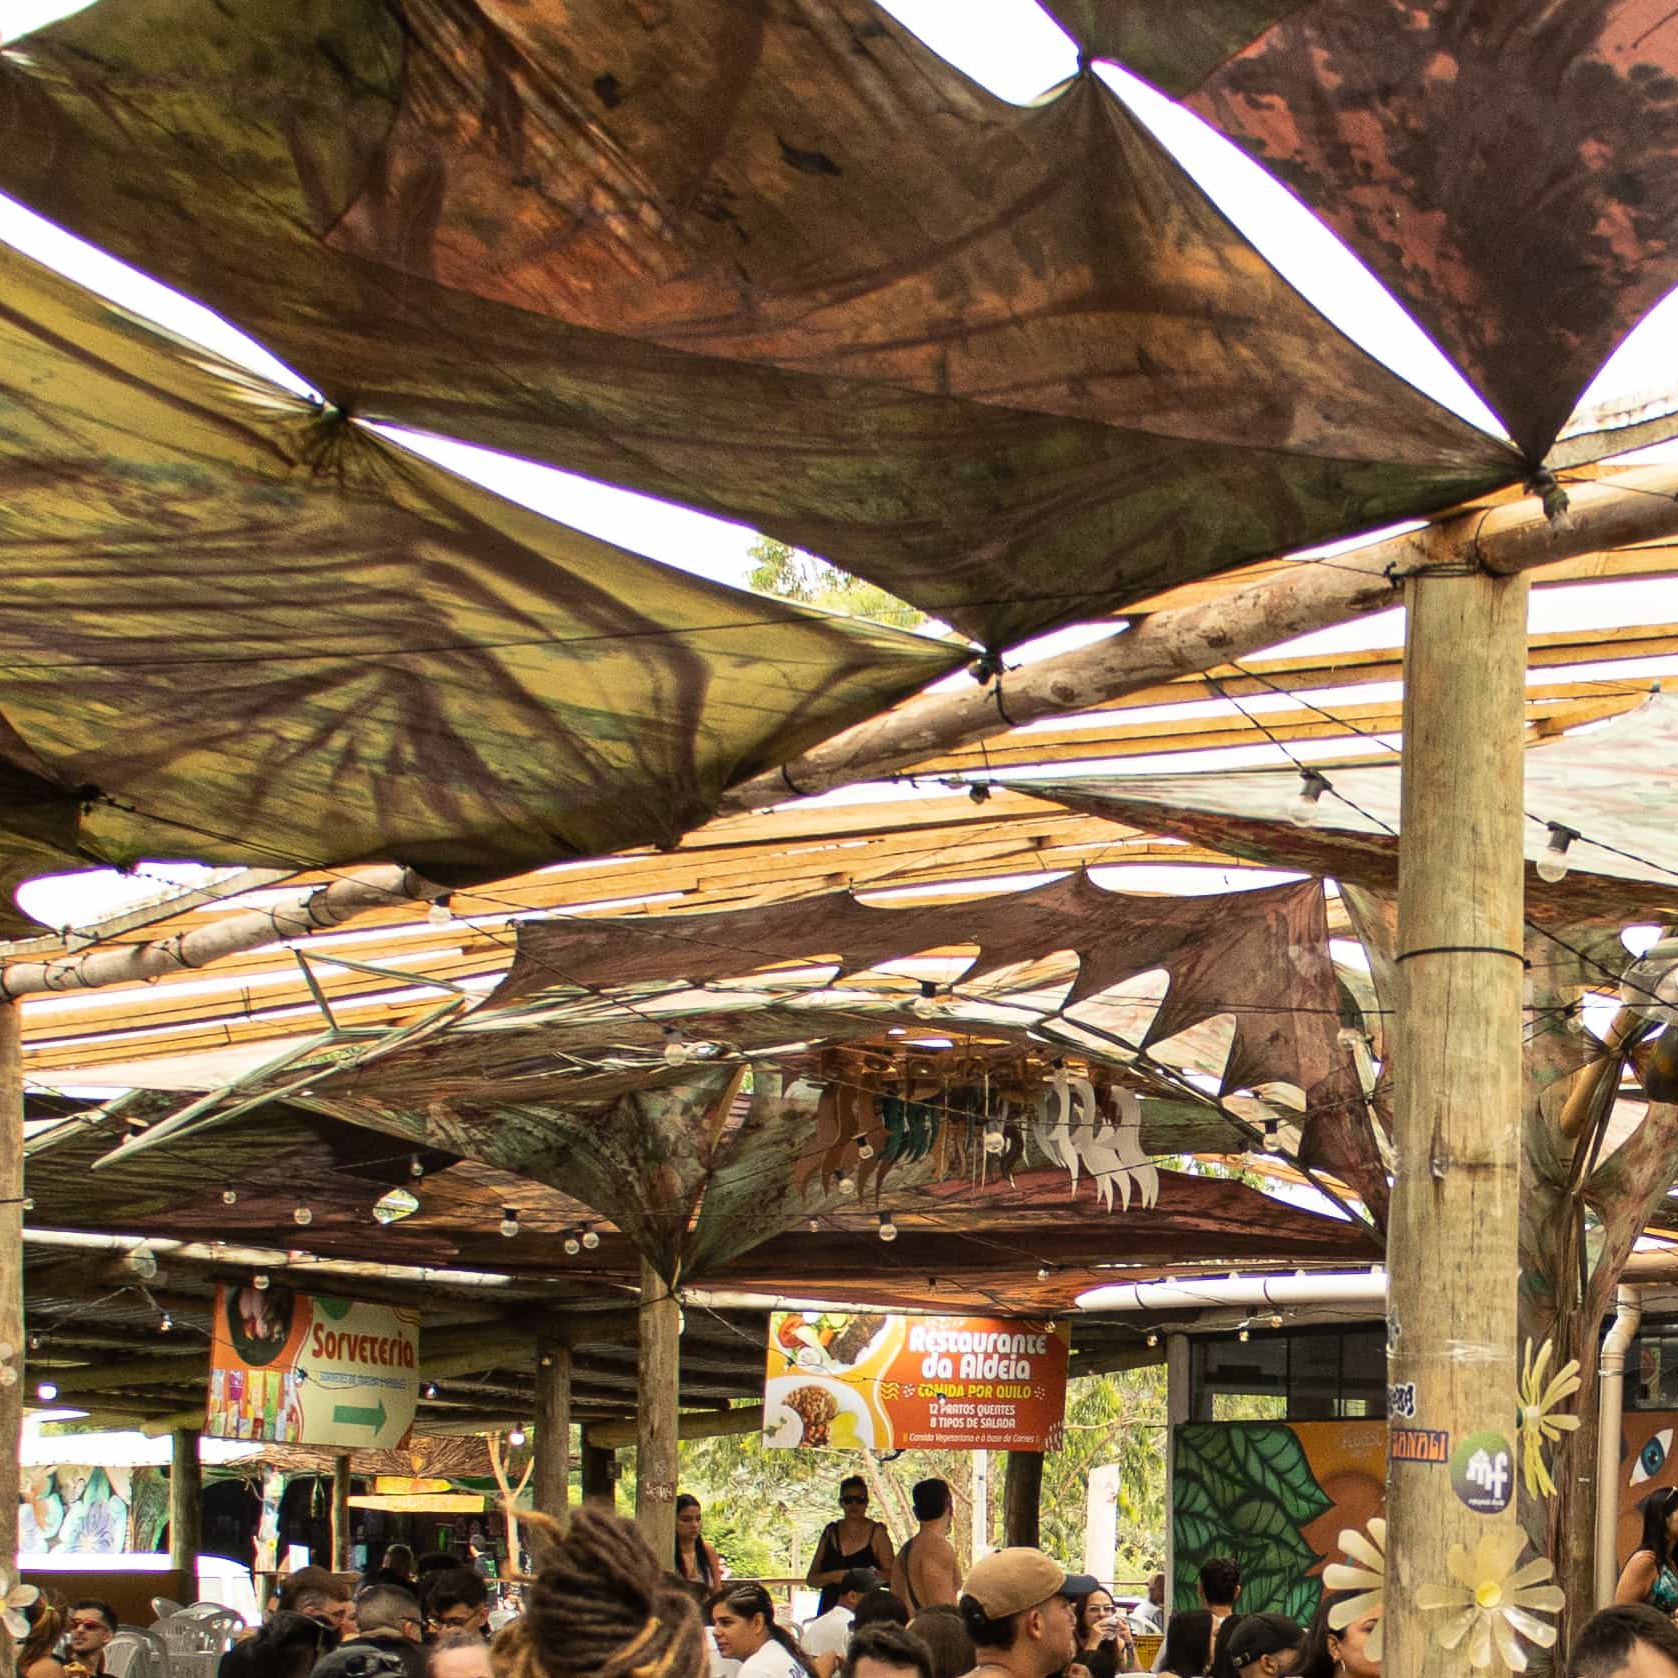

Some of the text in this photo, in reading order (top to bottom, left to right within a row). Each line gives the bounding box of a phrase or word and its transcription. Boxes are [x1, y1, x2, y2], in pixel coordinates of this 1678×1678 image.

[312, 1322, 415, 1369] Sorveteria
[909, 1325, 1047, 1354] Restaurante
[922, 1351, 1030, 1380] da Aldeia
[918, 1384, 1031, 1399] COMIDA POR QUILO
[929, 1404, 1016, 1417] 12 PRATOS QUENTES
[930, 1417, 1016, 1429] 8 TIPOS DE SALADA
